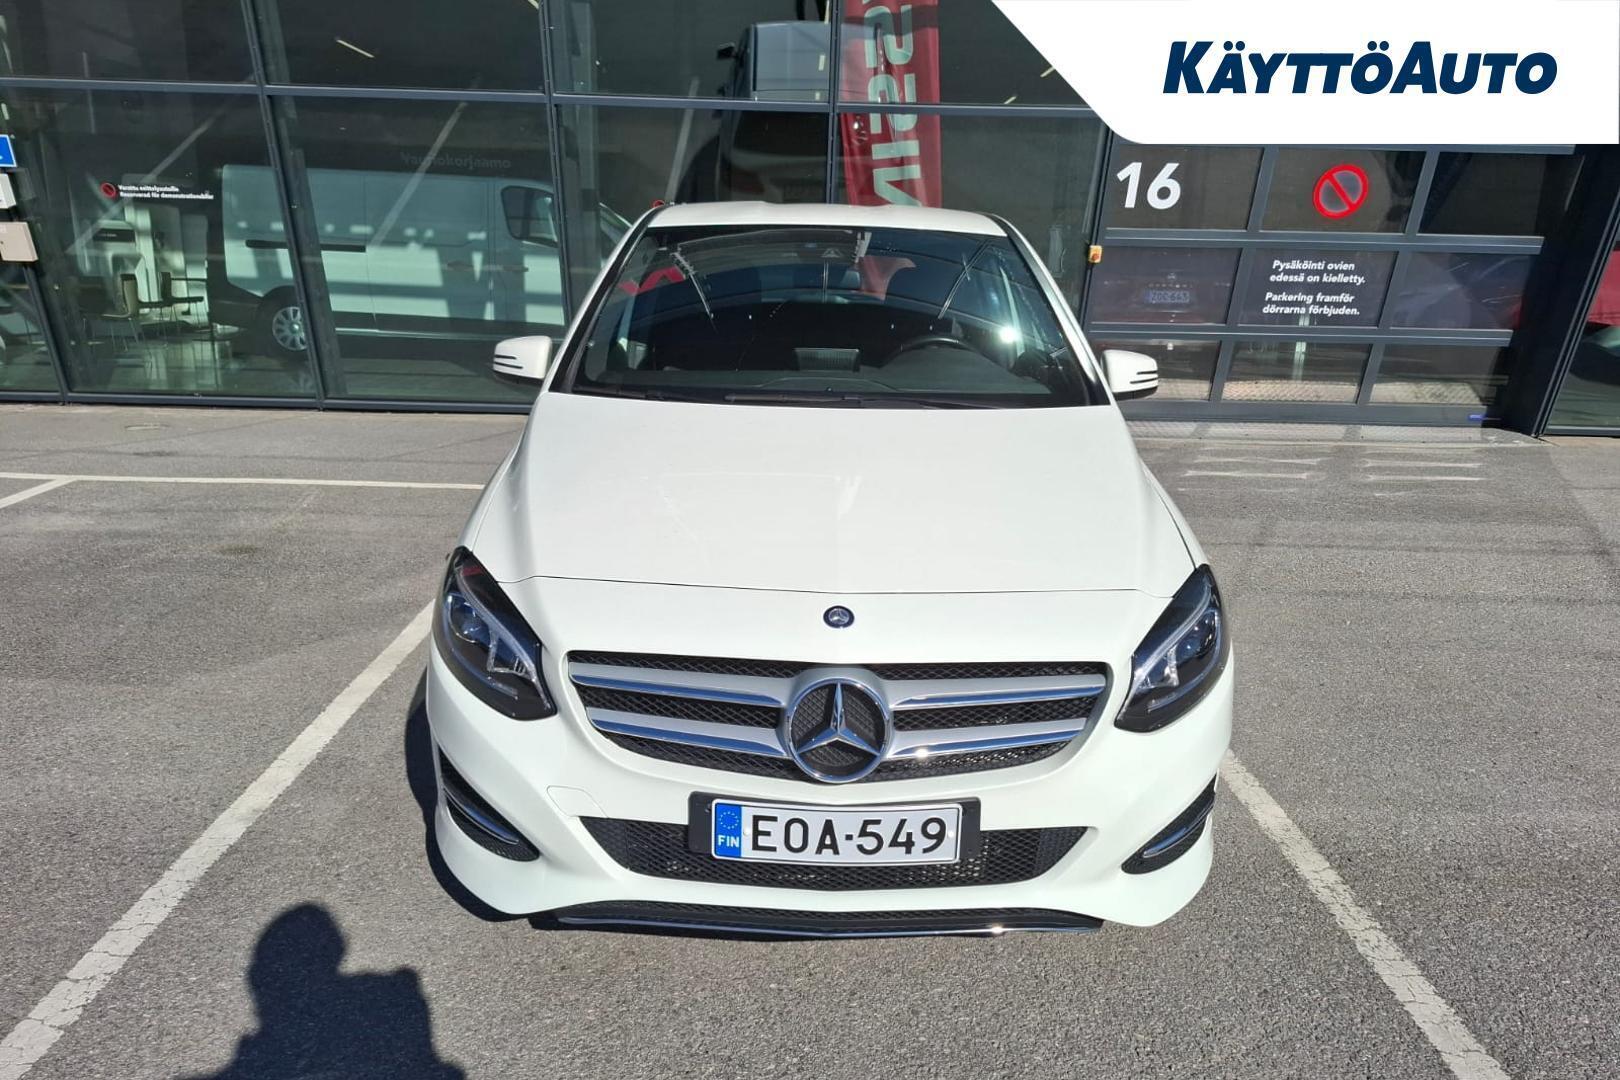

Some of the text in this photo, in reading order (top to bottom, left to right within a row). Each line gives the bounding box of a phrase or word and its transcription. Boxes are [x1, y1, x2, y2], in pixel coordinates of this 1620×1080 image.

[1116, 161, 1181, 210] 16
[1272, 259, 1356, 272] Pysäköinti ovien
[1269, 272, 1305, 282] edessä
[1322, 273, 1366, 286] kielletty.
[1265, 291, 1355, 304] Parkering framför
[1262, 304, 1361, 317] dörrarna förbjuden.
[717, 833, 740, 849] FIN
[751, 814, 947, 856] EOA-549
